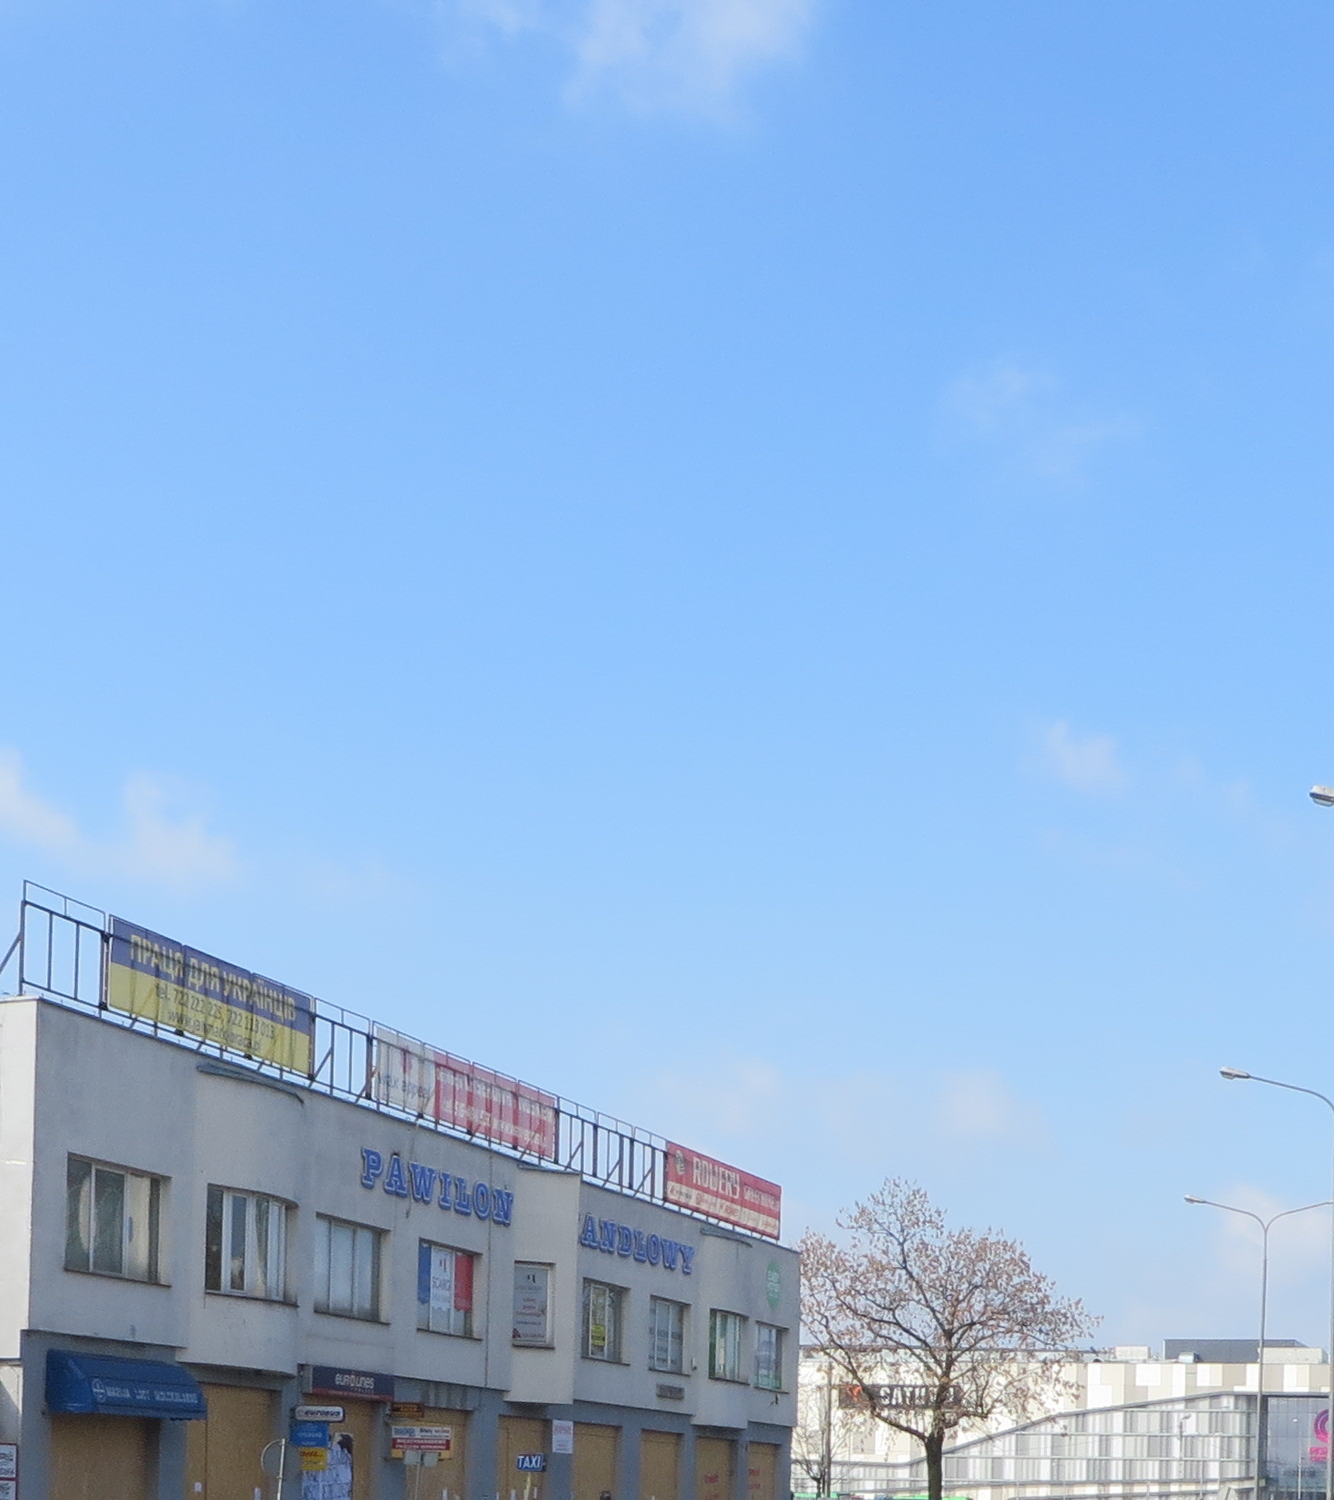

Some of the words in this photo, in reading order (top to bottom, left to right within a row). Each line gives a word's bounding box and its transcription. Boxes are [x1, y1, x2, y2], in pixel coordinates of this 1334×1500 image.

[361, 1147, 515, 1227] PAWILON
[692, 1156, 741, 1200] ROWERY
[517, 1455, 541, 1469] TAXI
